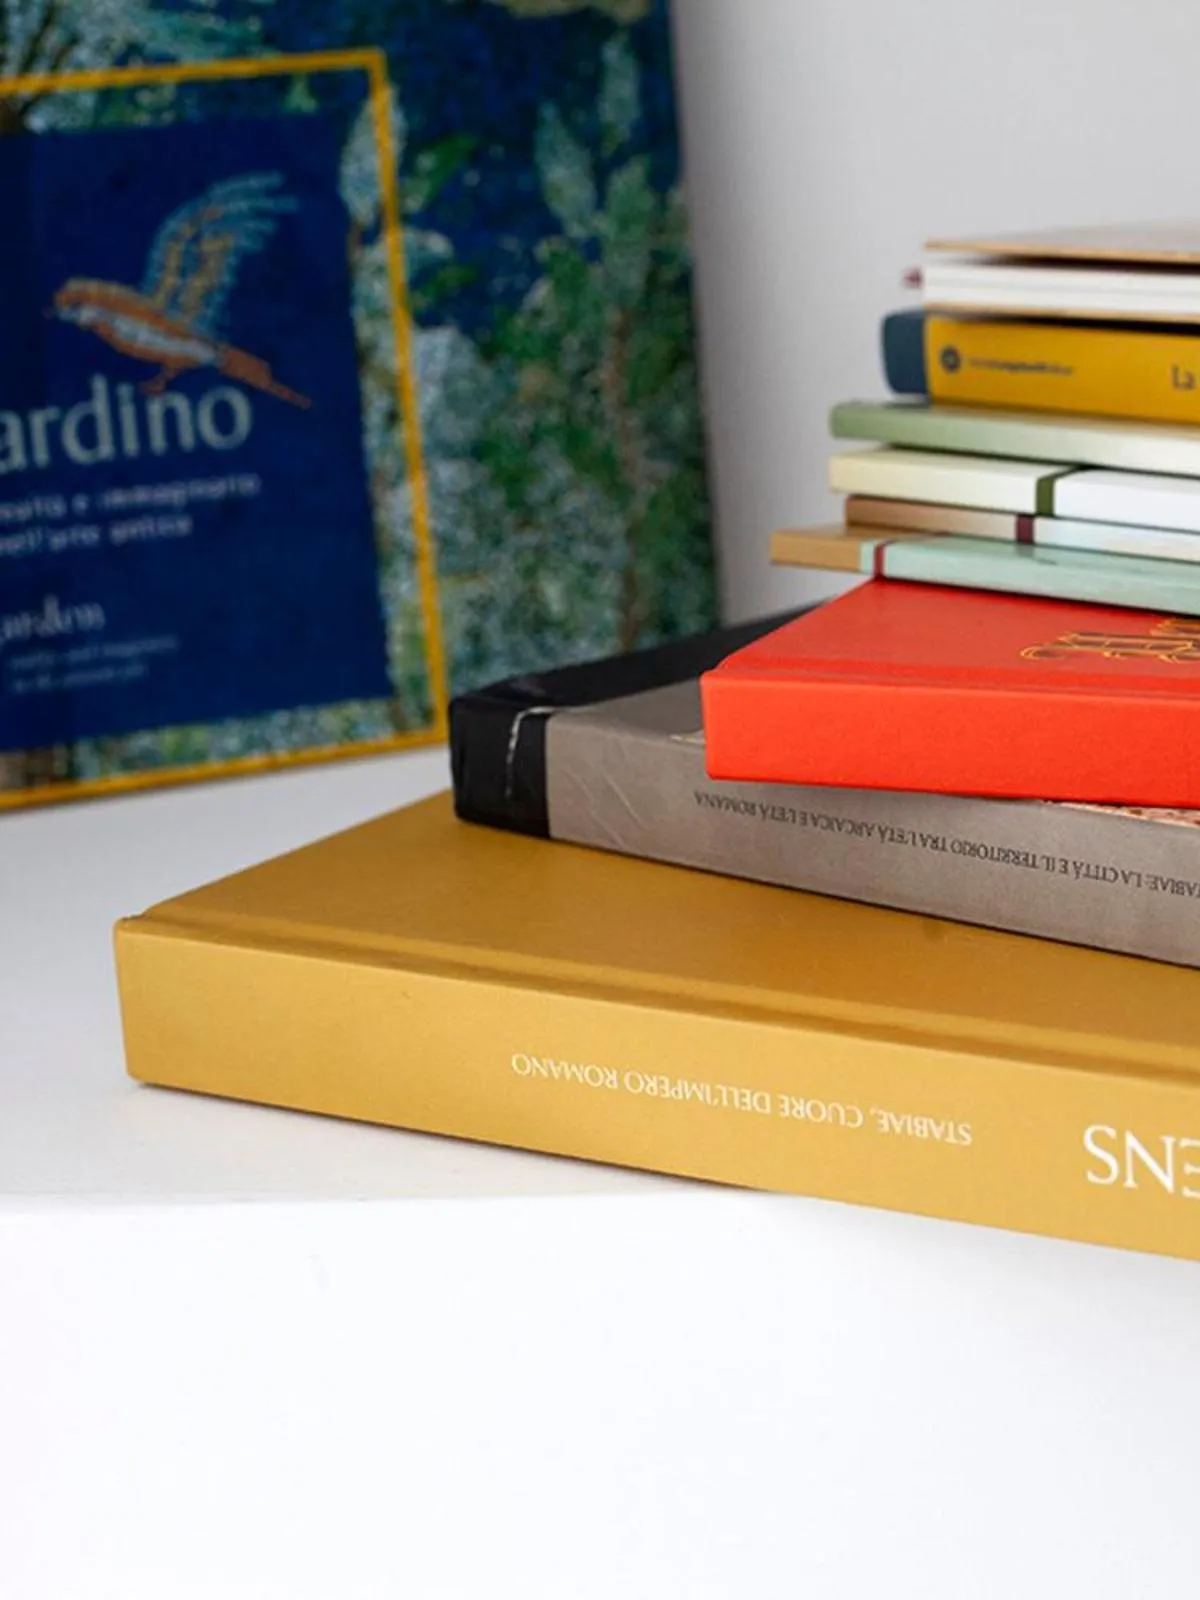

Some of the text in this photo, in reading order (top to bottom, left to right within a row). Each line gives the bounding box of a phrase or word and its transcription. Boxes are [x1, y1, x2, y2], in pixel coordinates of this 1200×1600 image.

[1172, 364, 1196, 391] La
[694, 790, 757, 817] ROMANA
[799, 811, 808, 827] E
[811, 816, 879, 838] ARCAICA
[918, 832, 948, 851] TRA
[950, 839, 1039, 869] TERRITORIO
[1042, 854, 1056, 872] IL
[1059, 858, 1069, 874] E
[1122, 869, 1142, 888] LA
[510, 1052, 974, 1147] STABIAE, CUORE DELL'IMPERO ROMANO
